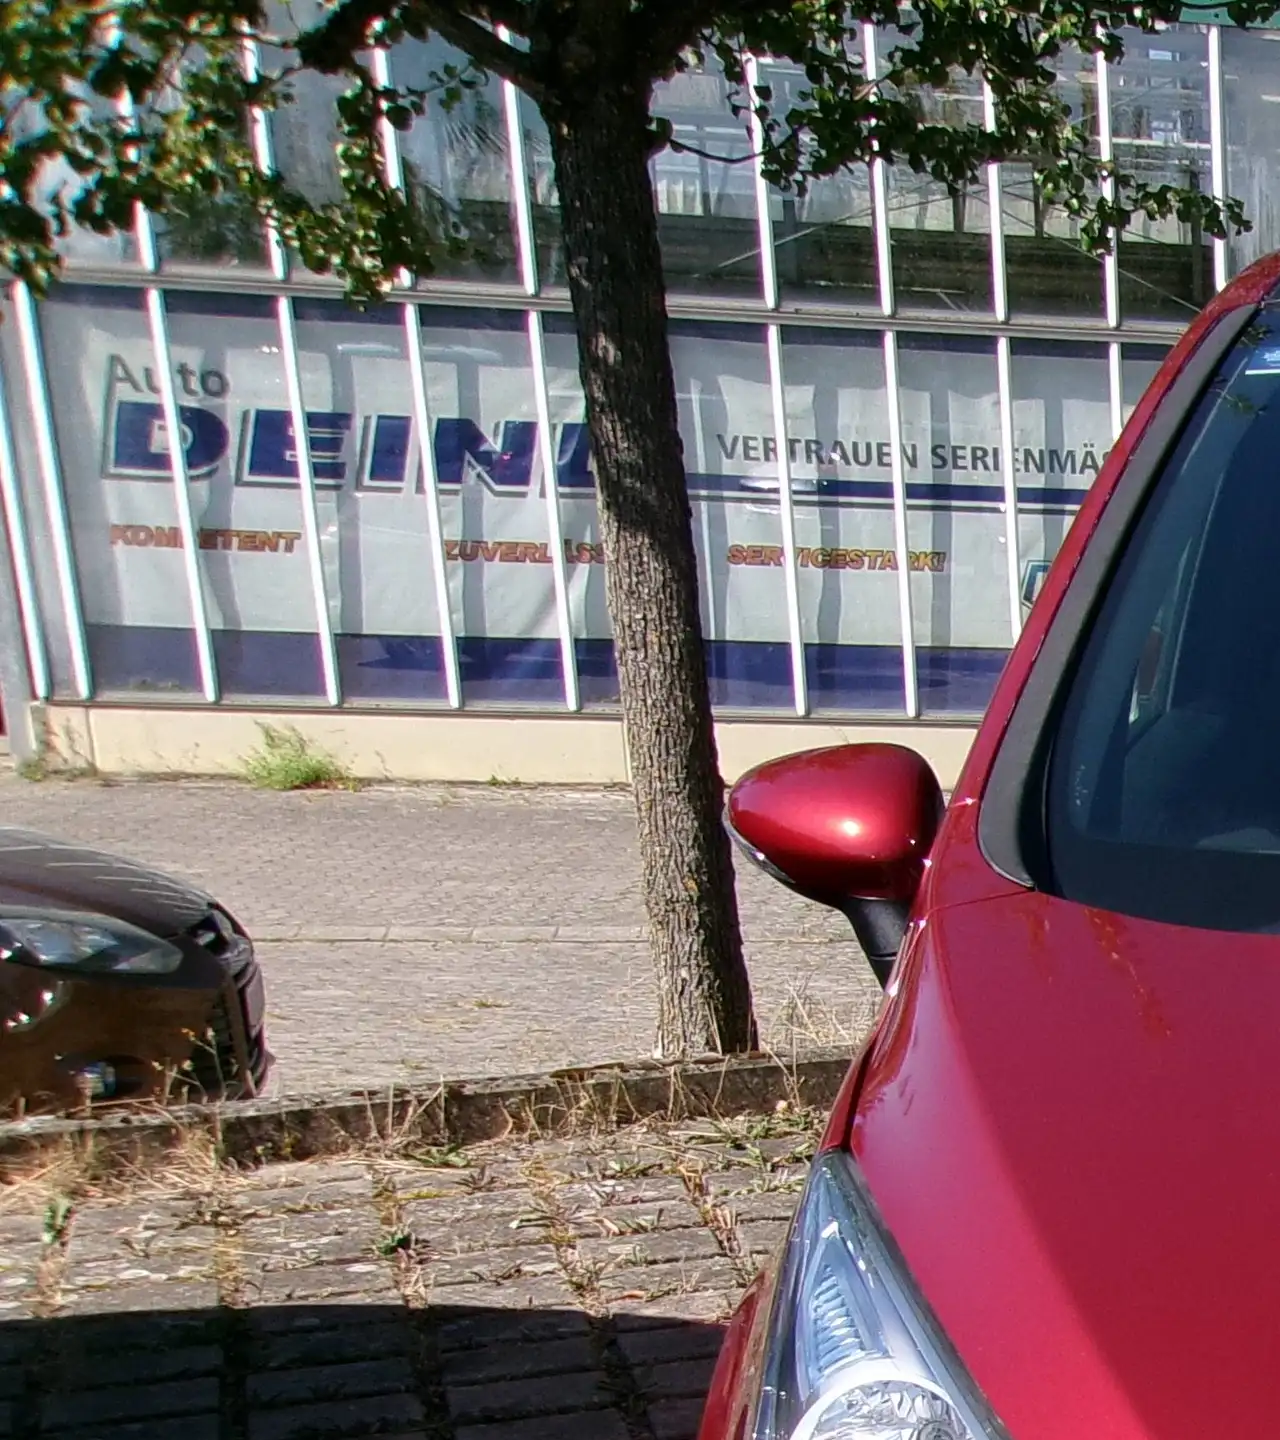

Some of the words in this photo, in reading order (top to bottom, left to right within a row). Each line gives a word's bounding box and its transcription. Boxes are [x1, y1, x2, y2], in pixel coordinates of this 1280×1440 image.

[107, 353, 231, 398] Auto
[715, 433, 919, 469] VERTRAUEN
[930, 442, 1111, 476] SERIENMÄ
[109, 524, 302, 553] KOMETENT
[727, 544, 946, 572] SERICESTARK!
